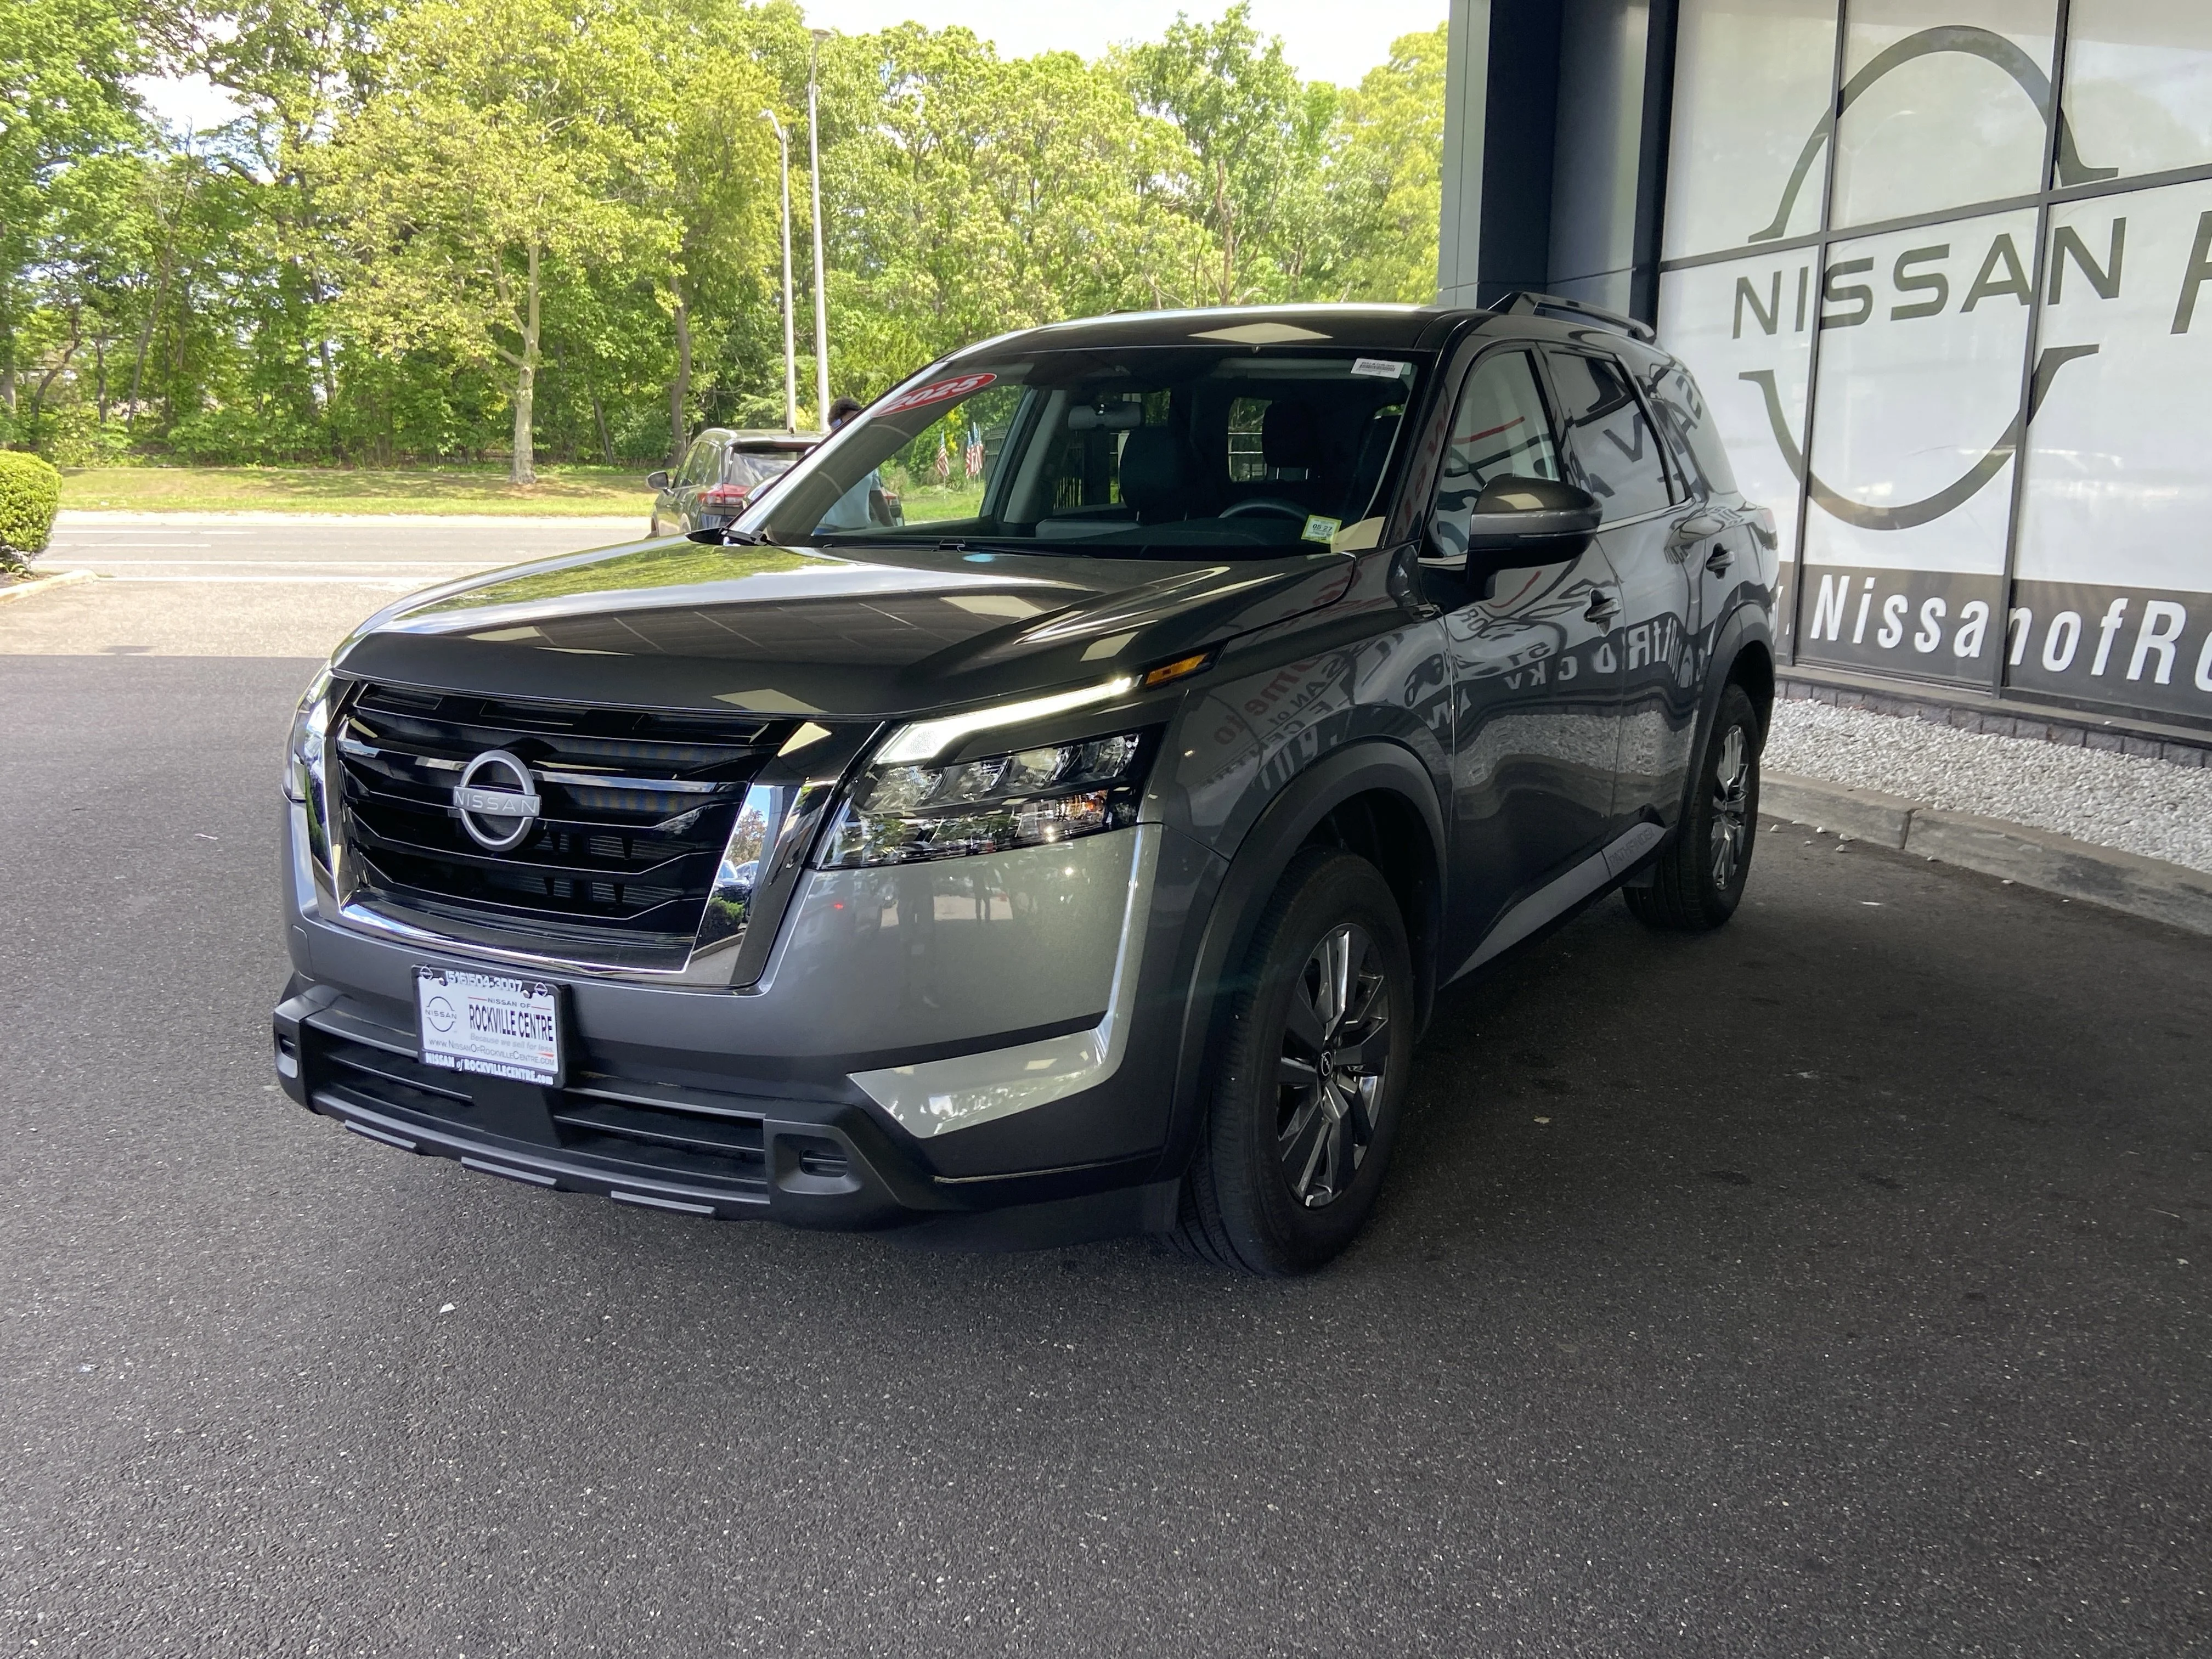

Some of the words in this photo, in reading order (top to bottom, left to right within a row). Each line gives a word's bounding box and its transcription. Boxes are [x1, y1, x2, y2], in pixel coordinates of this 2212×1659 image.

[1732, 217, 2127, 339] NISSAN
[455, 791, 536, 813] NISSAN
[488, 998, 517, 1007] NISSAN
[425, 1009, 456, 1019] NISSAN
[469, 1004, 516, 1036] ROCKVILLE
[518, 1011, 553, 1041] CENTRE
[470, 1033, 499, 1045] Because
[426, 1052, 455, 1068] NISSAN
[456, 1059, 464, 1071] of
